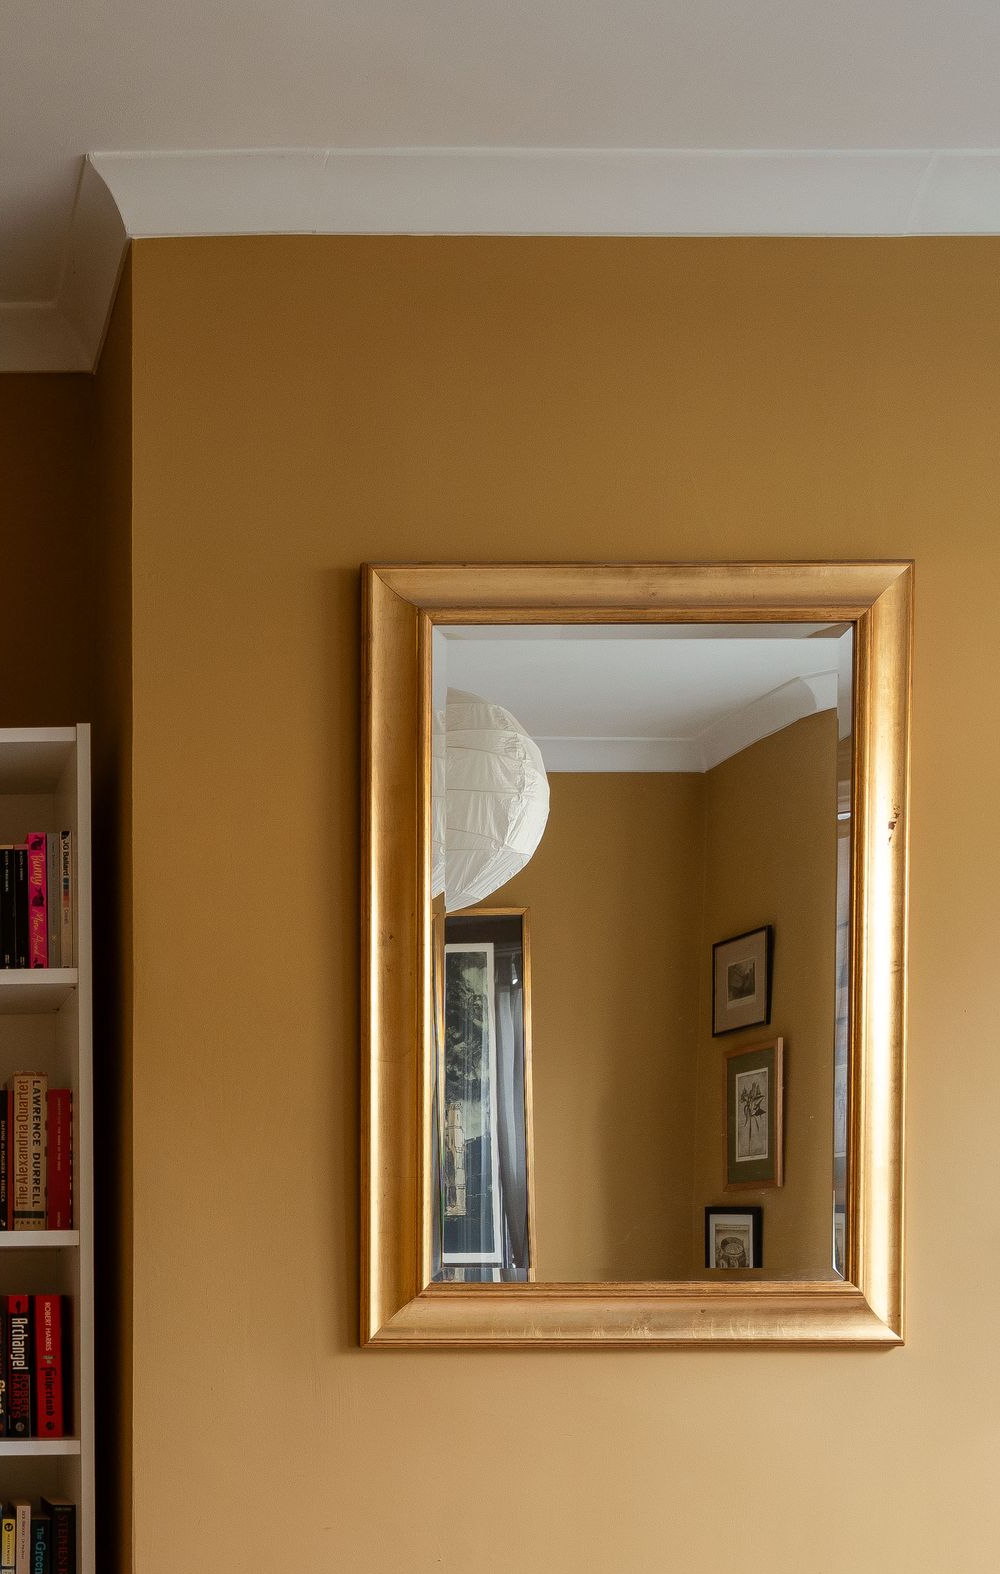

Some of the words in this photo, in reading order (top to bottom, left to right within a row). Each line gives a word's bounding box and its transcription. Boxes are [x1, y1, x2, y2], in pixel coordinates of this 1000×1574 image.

[62, 840, 69, 850] JG
[32, 853, 44, 886] Bunny
[16, 1080, 29, 1122] Quartet
[32, 1080, 40, 1146] LAWRENCE
[16, 1124, 29, 1184] Alexandria
[16, 1186, 28, 1206] The
[32, 1153, 40, 1208] DURRELL
[44, 1302, 52, 1326] ROBERT
[10, 1318, 29, 1370] Archangel
[44, 1328, 52, 1352] HARRIS
[12, 1374, 20, 1418] HARRIS
[20, 1374, 28, 1417] ROBERT
[36, 1528, 44, 1540] The
[56, 1514, 69, 1564] STEPHEN
[35, 1541, 46, 1574] Green
